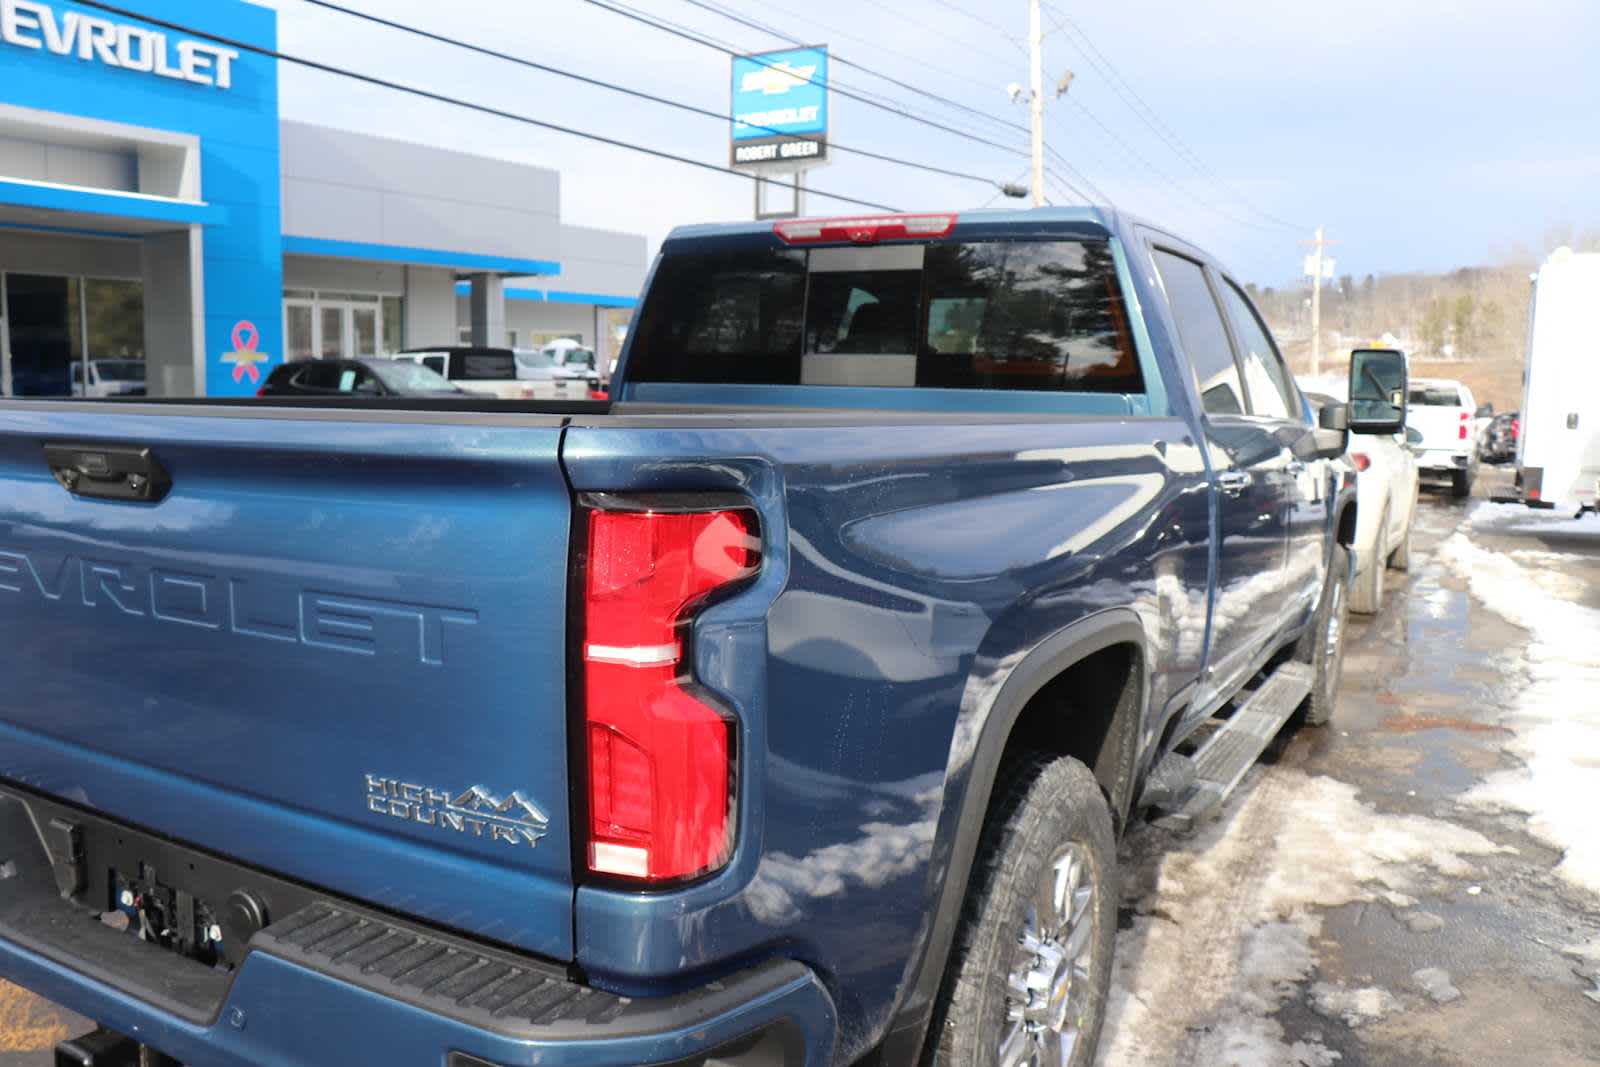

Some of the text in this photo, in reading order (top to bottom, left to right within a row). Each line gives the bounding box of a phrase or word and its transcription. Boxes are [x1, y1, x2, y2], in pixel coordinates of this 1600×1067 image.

[0, 0, 240, 89] EVROLET
[736, 141, 818, 161] ROBERT GREEN
[365, 773, 452, 806] HIGH
[367, 793, 549, 848] COUNTRY
